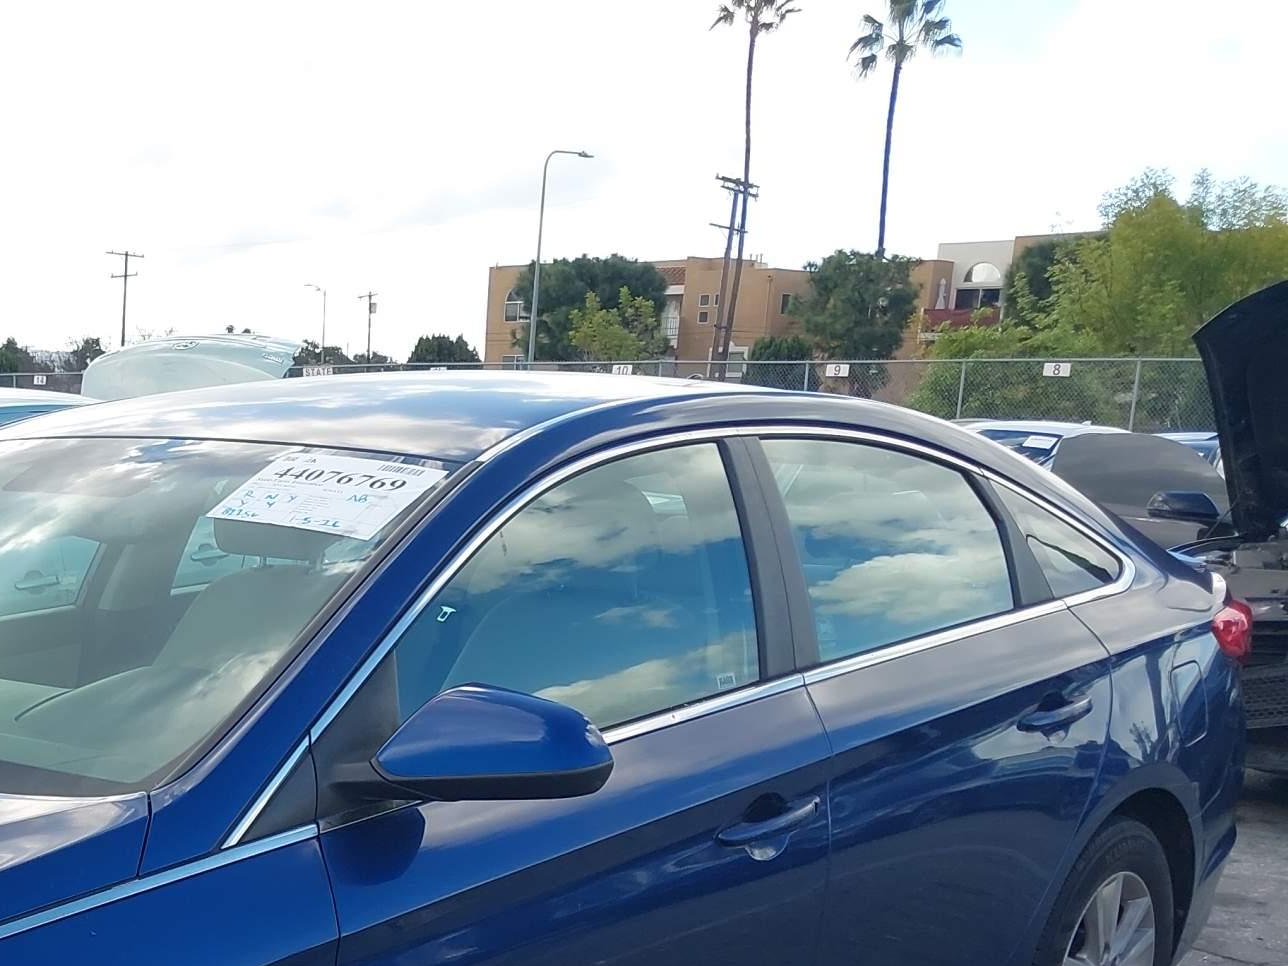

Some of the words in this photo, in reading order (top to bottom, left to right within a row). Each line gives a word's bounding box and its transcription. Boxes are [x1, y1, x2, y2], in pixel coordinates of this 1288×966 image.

[305, 366, 332, 377] STATE
[833, 364, 841, 376] 9
[1052, 363, 1061, 376] 8
[274, 466, 408, 492] 44076769
